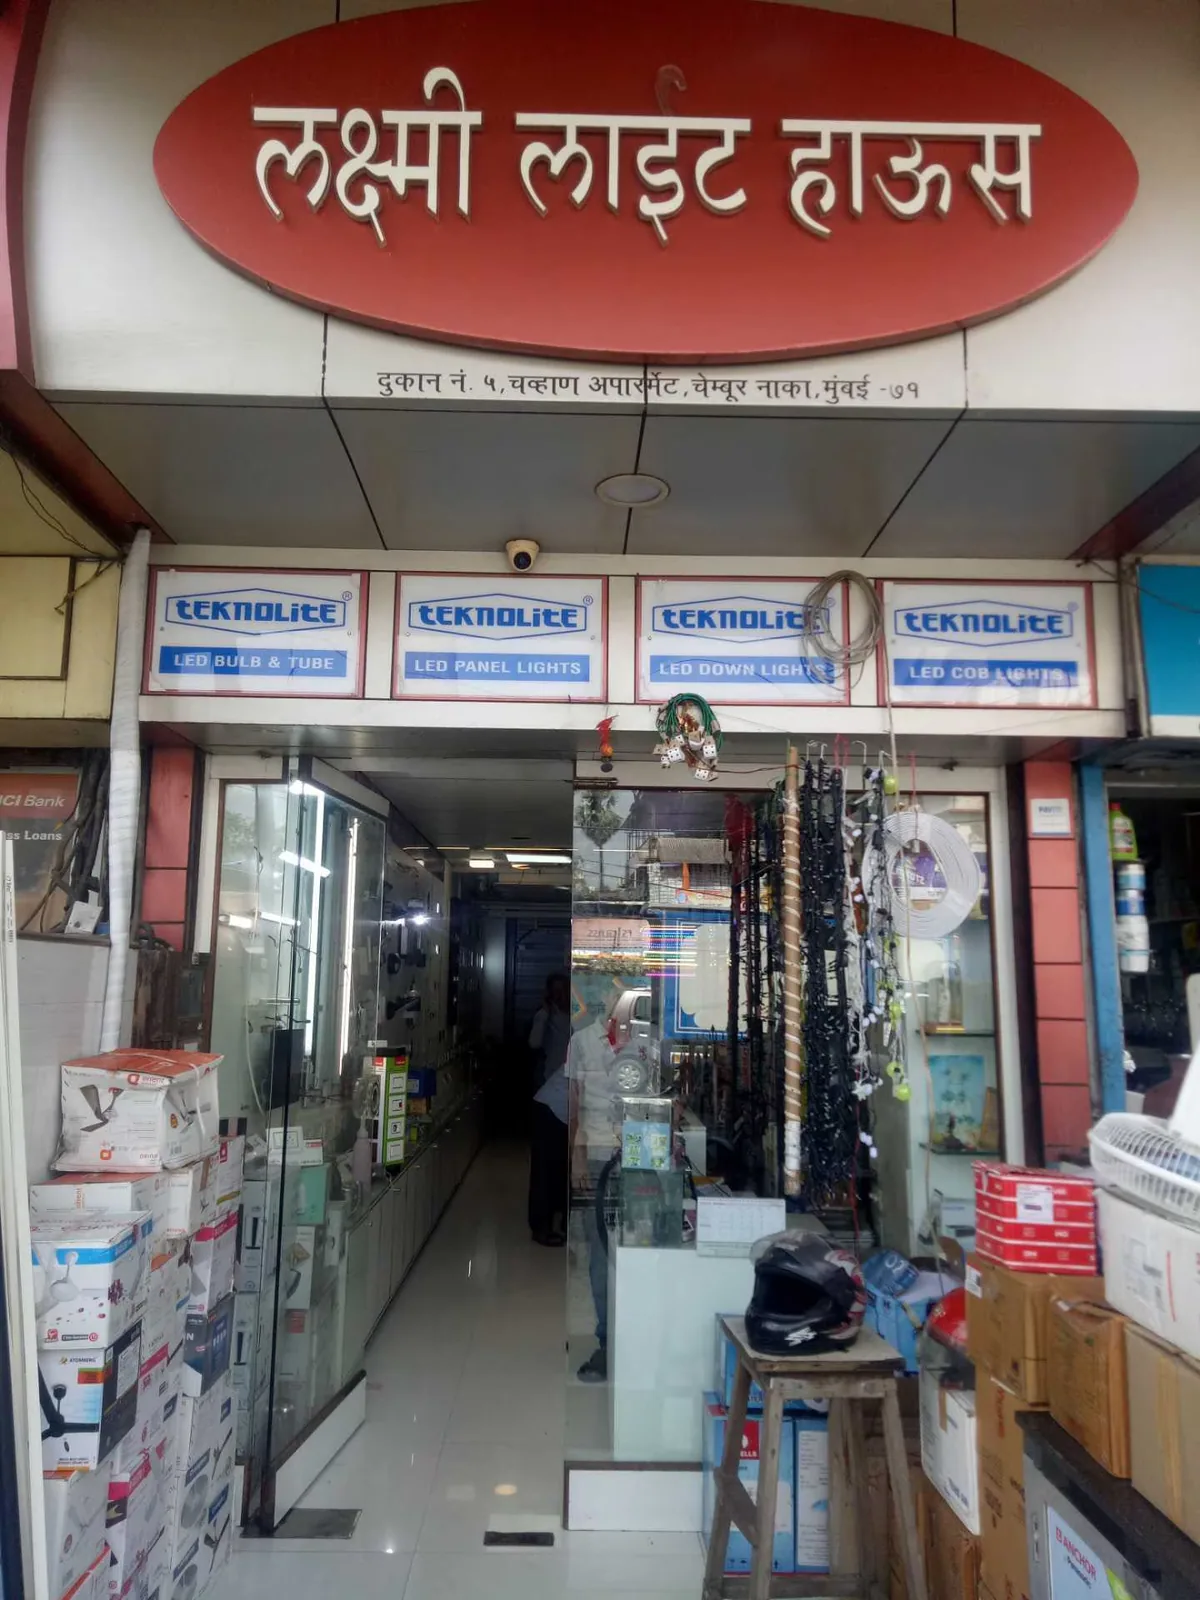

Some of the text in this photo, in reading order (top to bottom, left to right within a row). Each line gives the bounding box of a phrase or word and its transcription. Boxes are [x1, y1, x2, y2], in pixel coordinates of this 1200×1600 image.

[252, 66, 482, 245] लक्ष्मी
[780, 118, 1043, 237] हाऊस
[376, 371, 443, 397] दुकान
[173, 653, 335, 670] LED BULB & TUBE
[414, 659, 582, 675] LED PANEL LIGHTS
[659, 662, 827, 677] LED DOWN LIGHTS
[909, 666, 1065, 682] LED COB LIGHTS
[23, 794, 66, 808] Bank
[23, 830, 63, 841] Loans
[1062, 1536, 1097, 1580] ANCHOR
